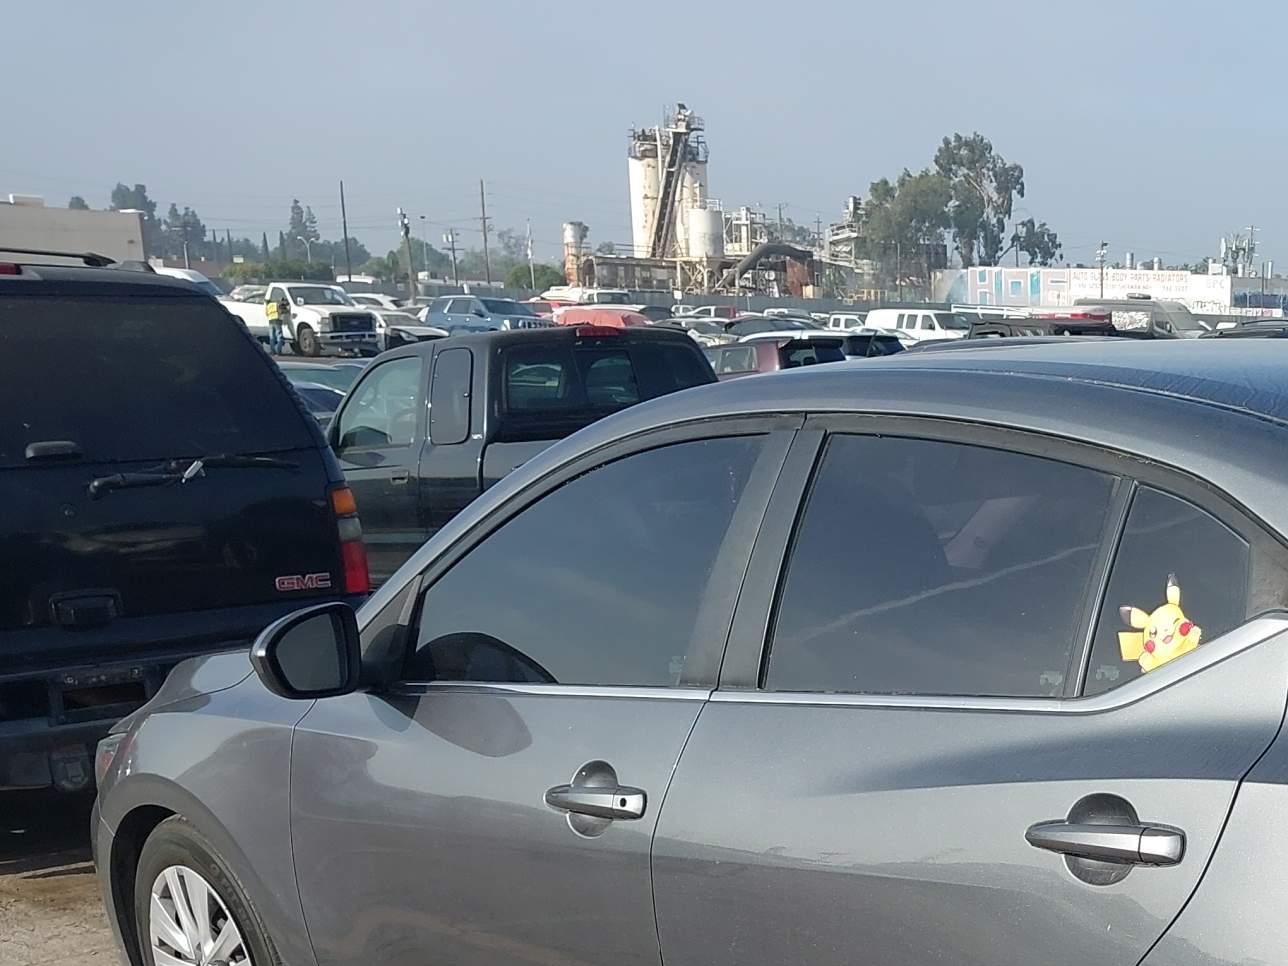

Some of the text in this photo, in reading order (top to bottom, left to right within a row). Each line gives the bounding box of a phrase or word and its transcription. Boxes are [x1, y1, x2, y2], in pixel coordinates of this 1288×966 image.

[1072, 271, 1188, 283] AUTO GLAS BODY PARTS RADIATORS
[275, 573, 331, 591] GMC
